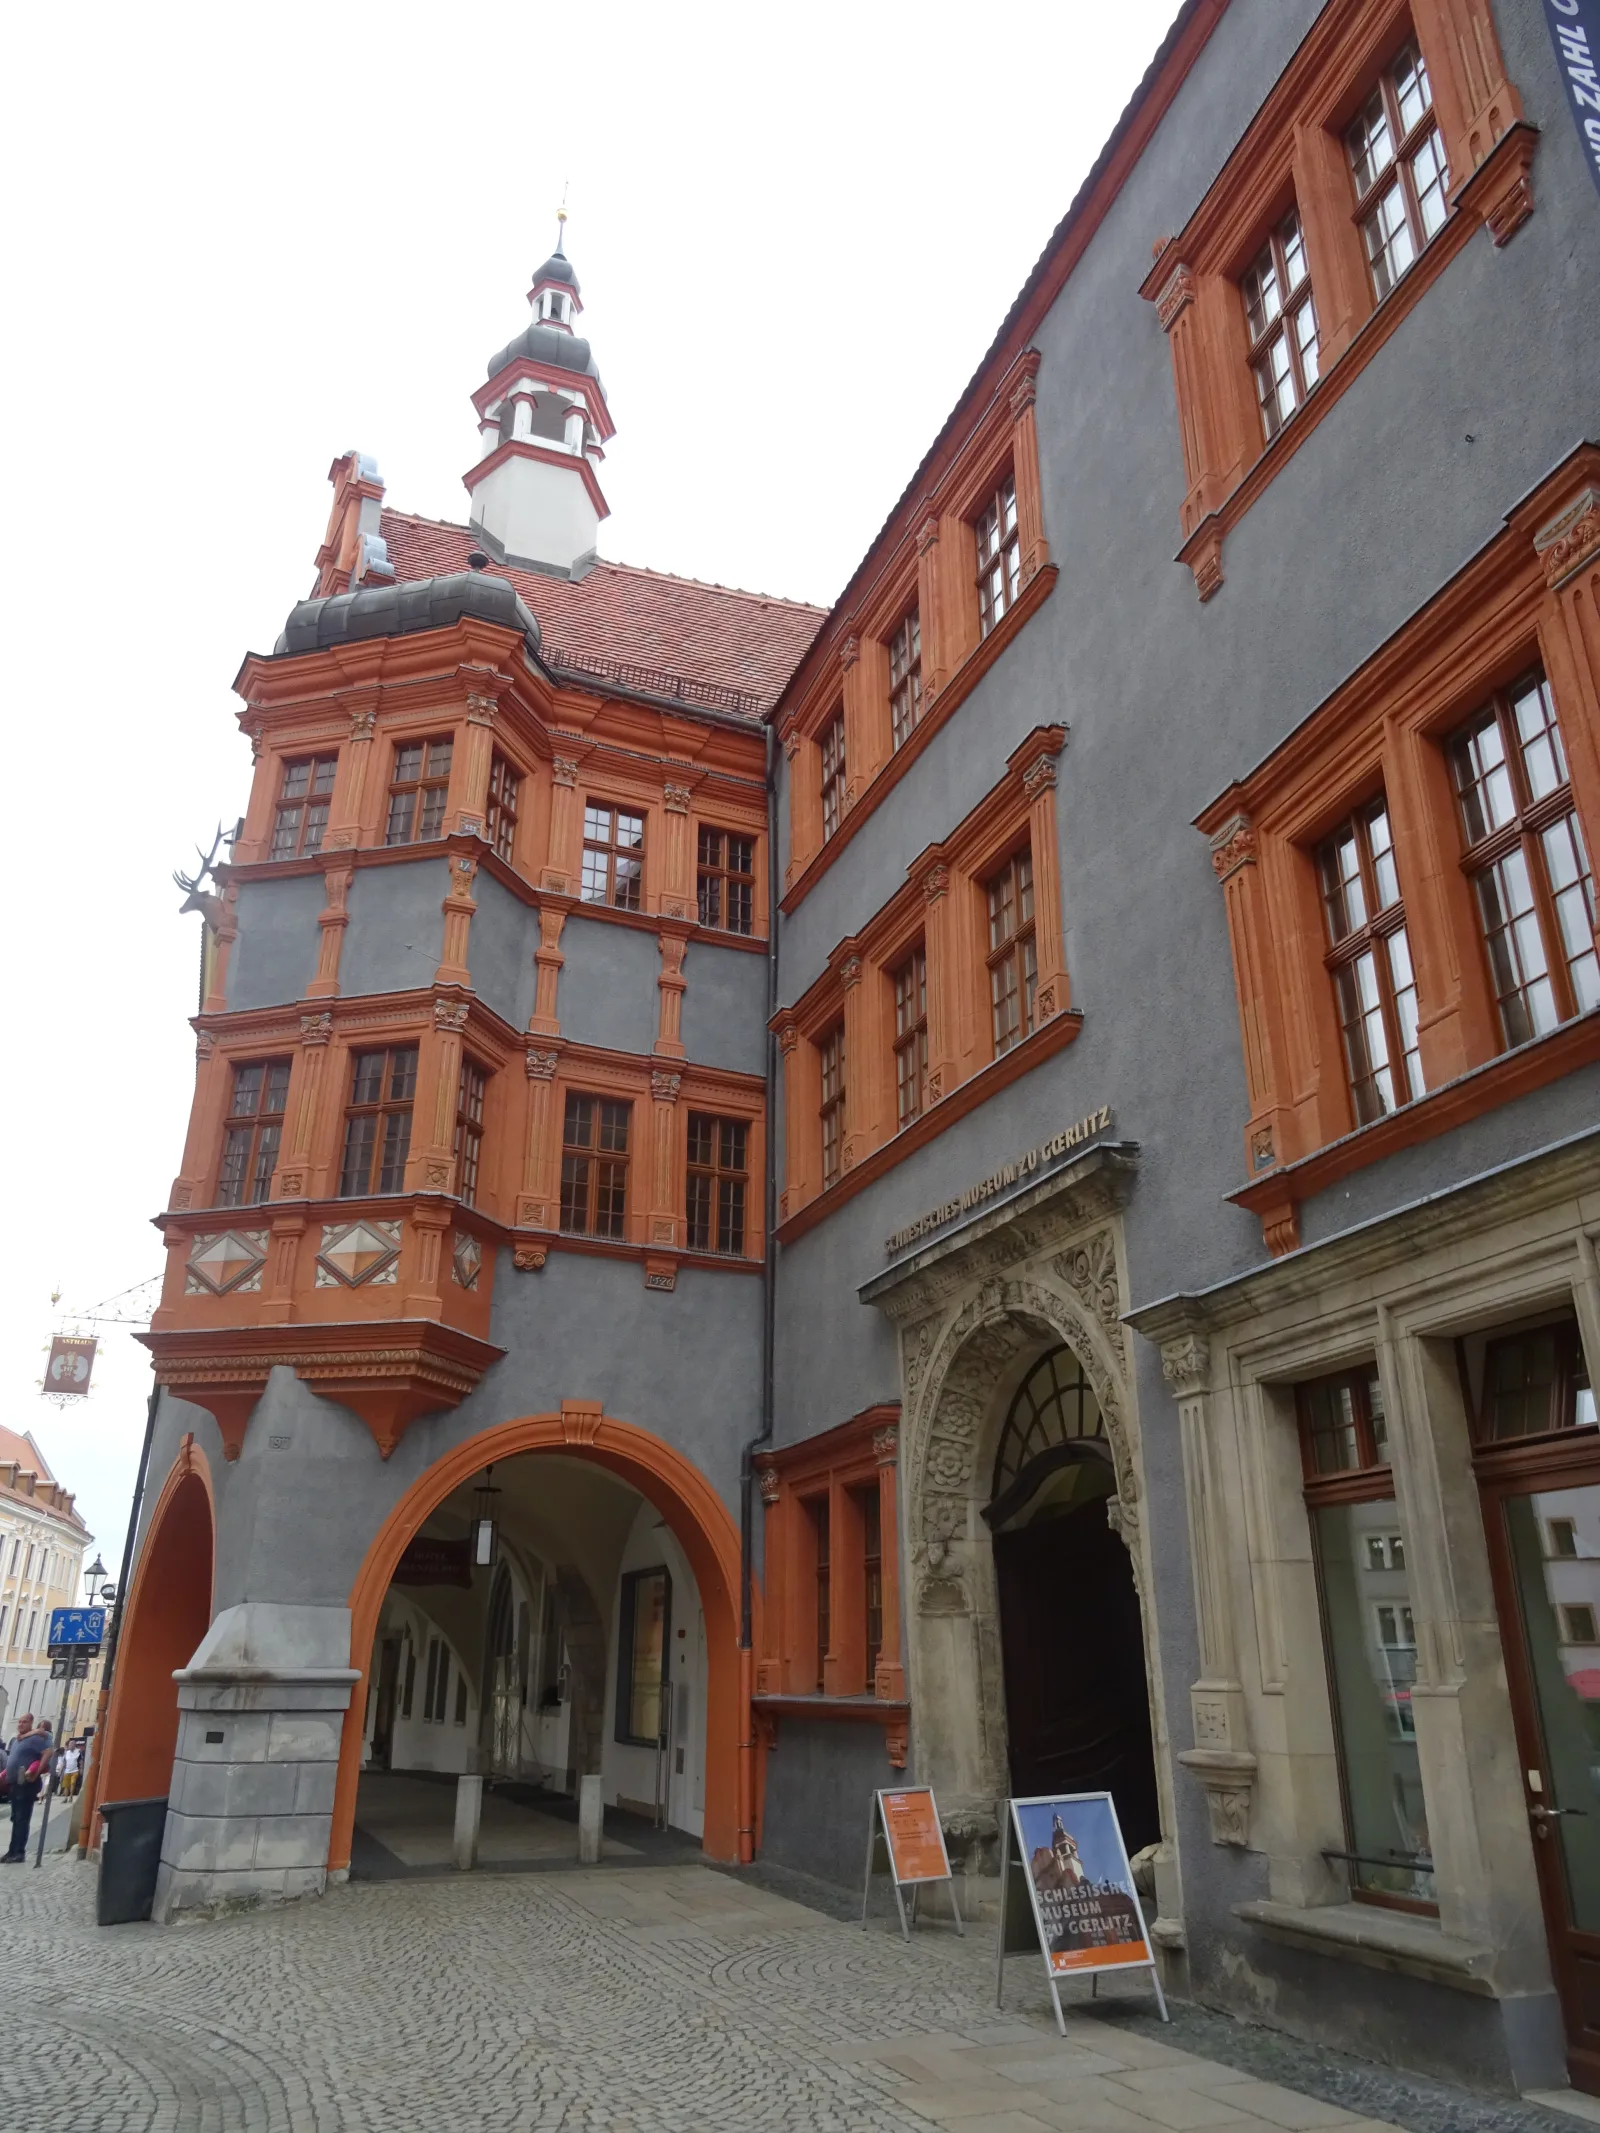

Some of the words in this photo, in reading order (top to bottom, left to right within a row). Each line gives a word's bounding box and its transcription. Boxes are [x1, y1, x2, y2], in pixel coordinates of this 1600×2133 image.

[959, 1163, 1017, 1213] MUSEUM
[1016, 1150, 1037, 1178] ZU
[55, 1337, 93, 1345] ASTHAUS
[1036, 1880, 1132, 1904] SCHLESISCHE
[1041, 1900, 1102, 1920] MUSEUM
